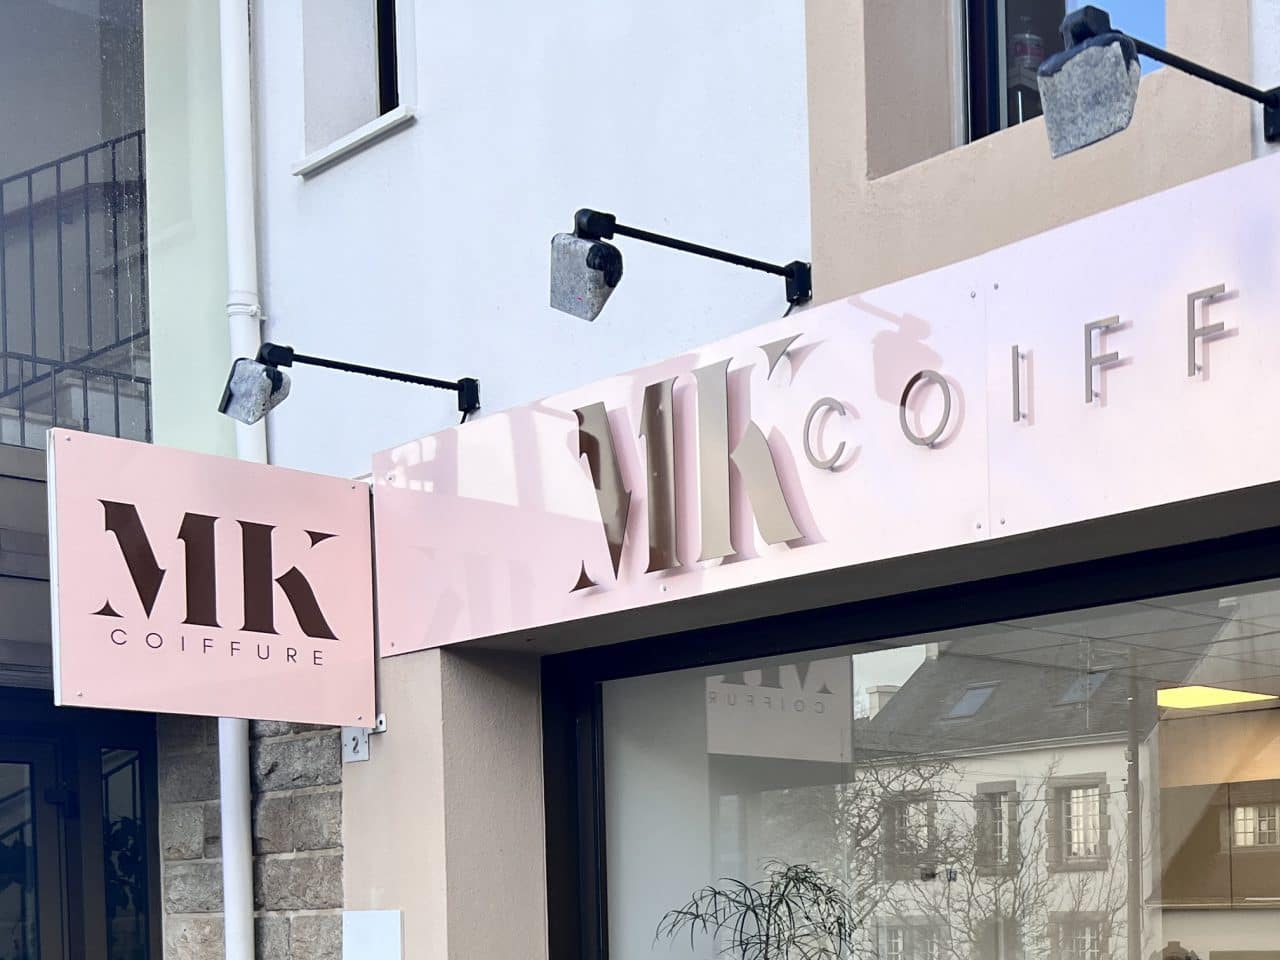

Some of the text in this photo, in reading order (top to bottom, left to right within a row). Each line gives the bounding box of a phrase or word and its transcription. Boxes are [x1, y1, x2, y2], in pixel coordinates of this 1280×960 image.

[570, 333, 803, 593] MK
[90, 499, 340, 641] MK
[110, 628, 324, 666] COIFFURE
[352, 735, 360, 754] 2
